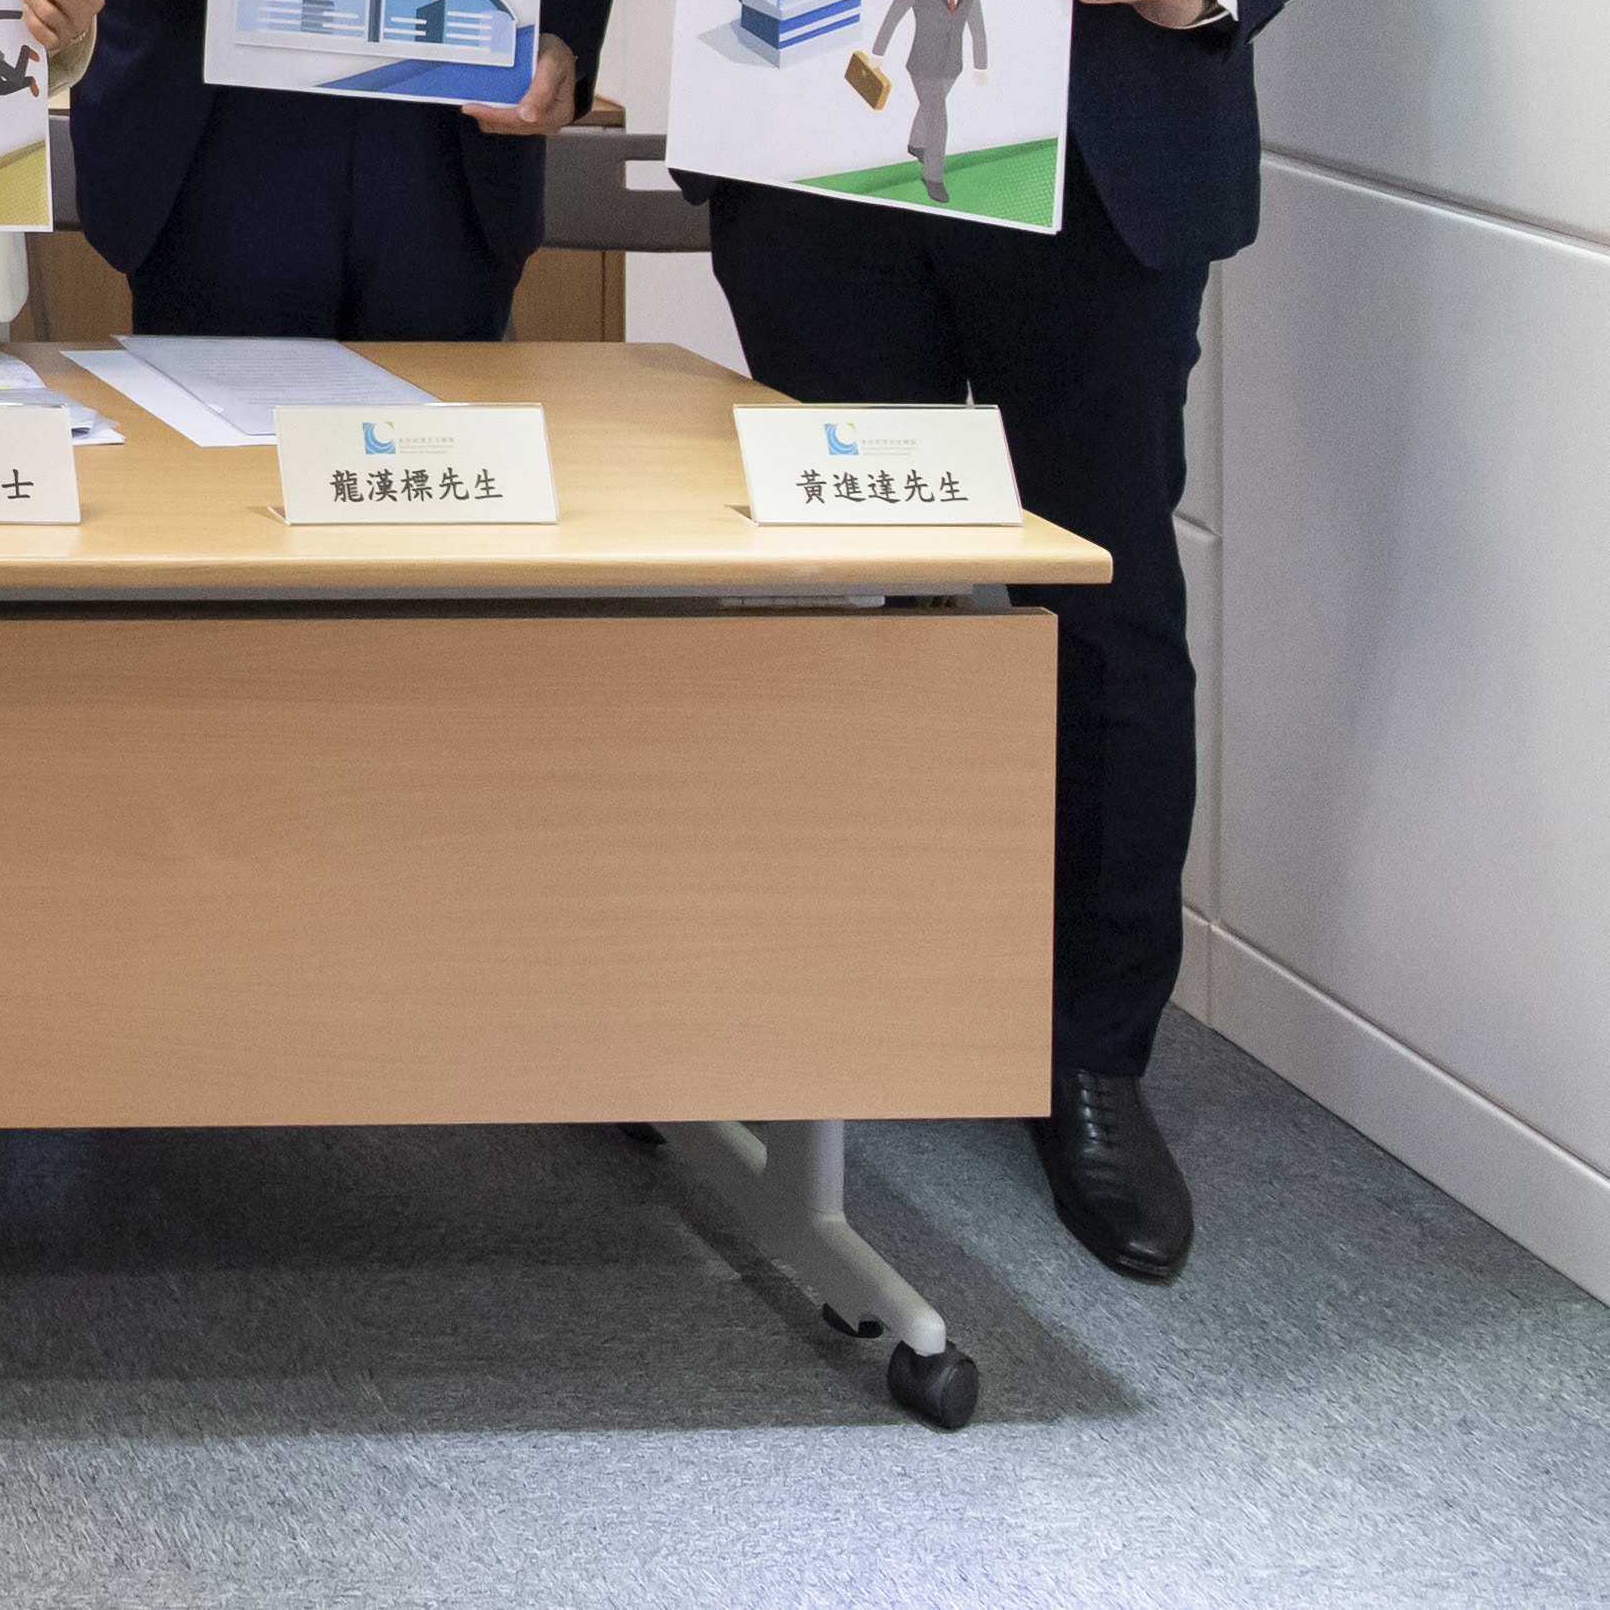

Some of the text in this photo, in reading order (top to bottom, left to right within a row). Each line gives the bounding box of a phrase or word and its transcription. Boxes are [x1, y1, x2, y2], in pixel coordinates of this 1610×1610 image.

[329, 467, 504, 503] 龍漢標先生
[796, 469, 969, 504] 黃進達先生
